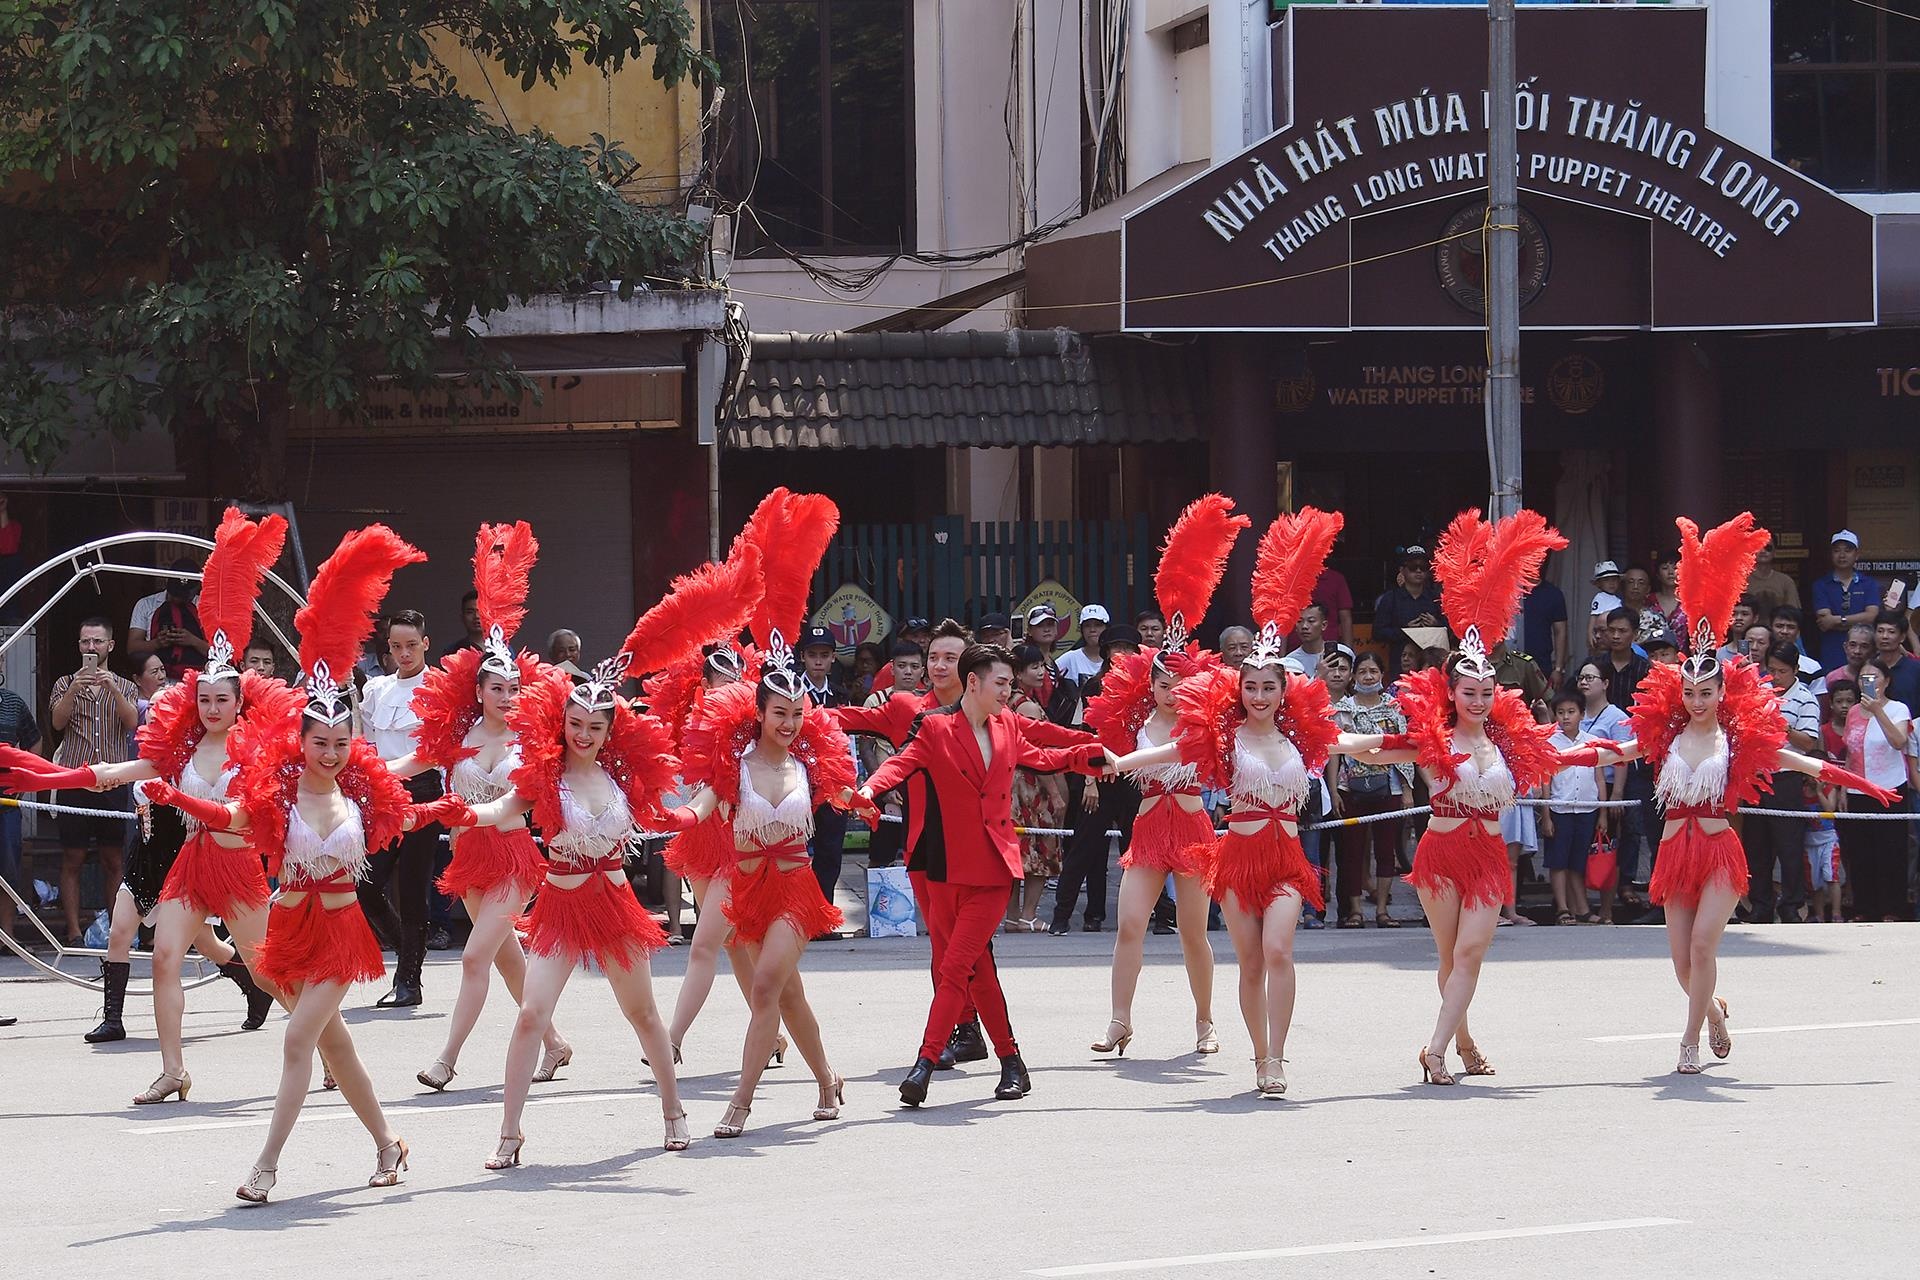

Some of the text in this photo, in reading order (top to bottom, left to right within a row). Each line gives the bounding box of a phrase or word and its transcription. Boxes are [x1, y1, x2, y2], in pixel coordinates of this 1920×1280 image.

[1202, 157, 1288, 242] NHÀ
[1284, 116, 1363, 183] HÁT
[1373, 88, 1469, 147] MÚA
[1567, 98, 1697, 170] THĂNG
[1697, 146, 1800, 237] LONG
[1263, 152, 1737, 262] THANG LONG WAT PUPPET THEATRE
[1362, 366, 1487, 385] THANG LON
[1327, 388, 1392, 406] WATER
[1393, 387, 1456, 405] PUPPET
[1872, 561, 1894, 571] TICKET
[832, 593, 854, 605] WATER
[854, 594, 875, 609] PUPPET
[1032, 590, 1054, 601] WATER
[1592, 601, 1599, 611] 3
